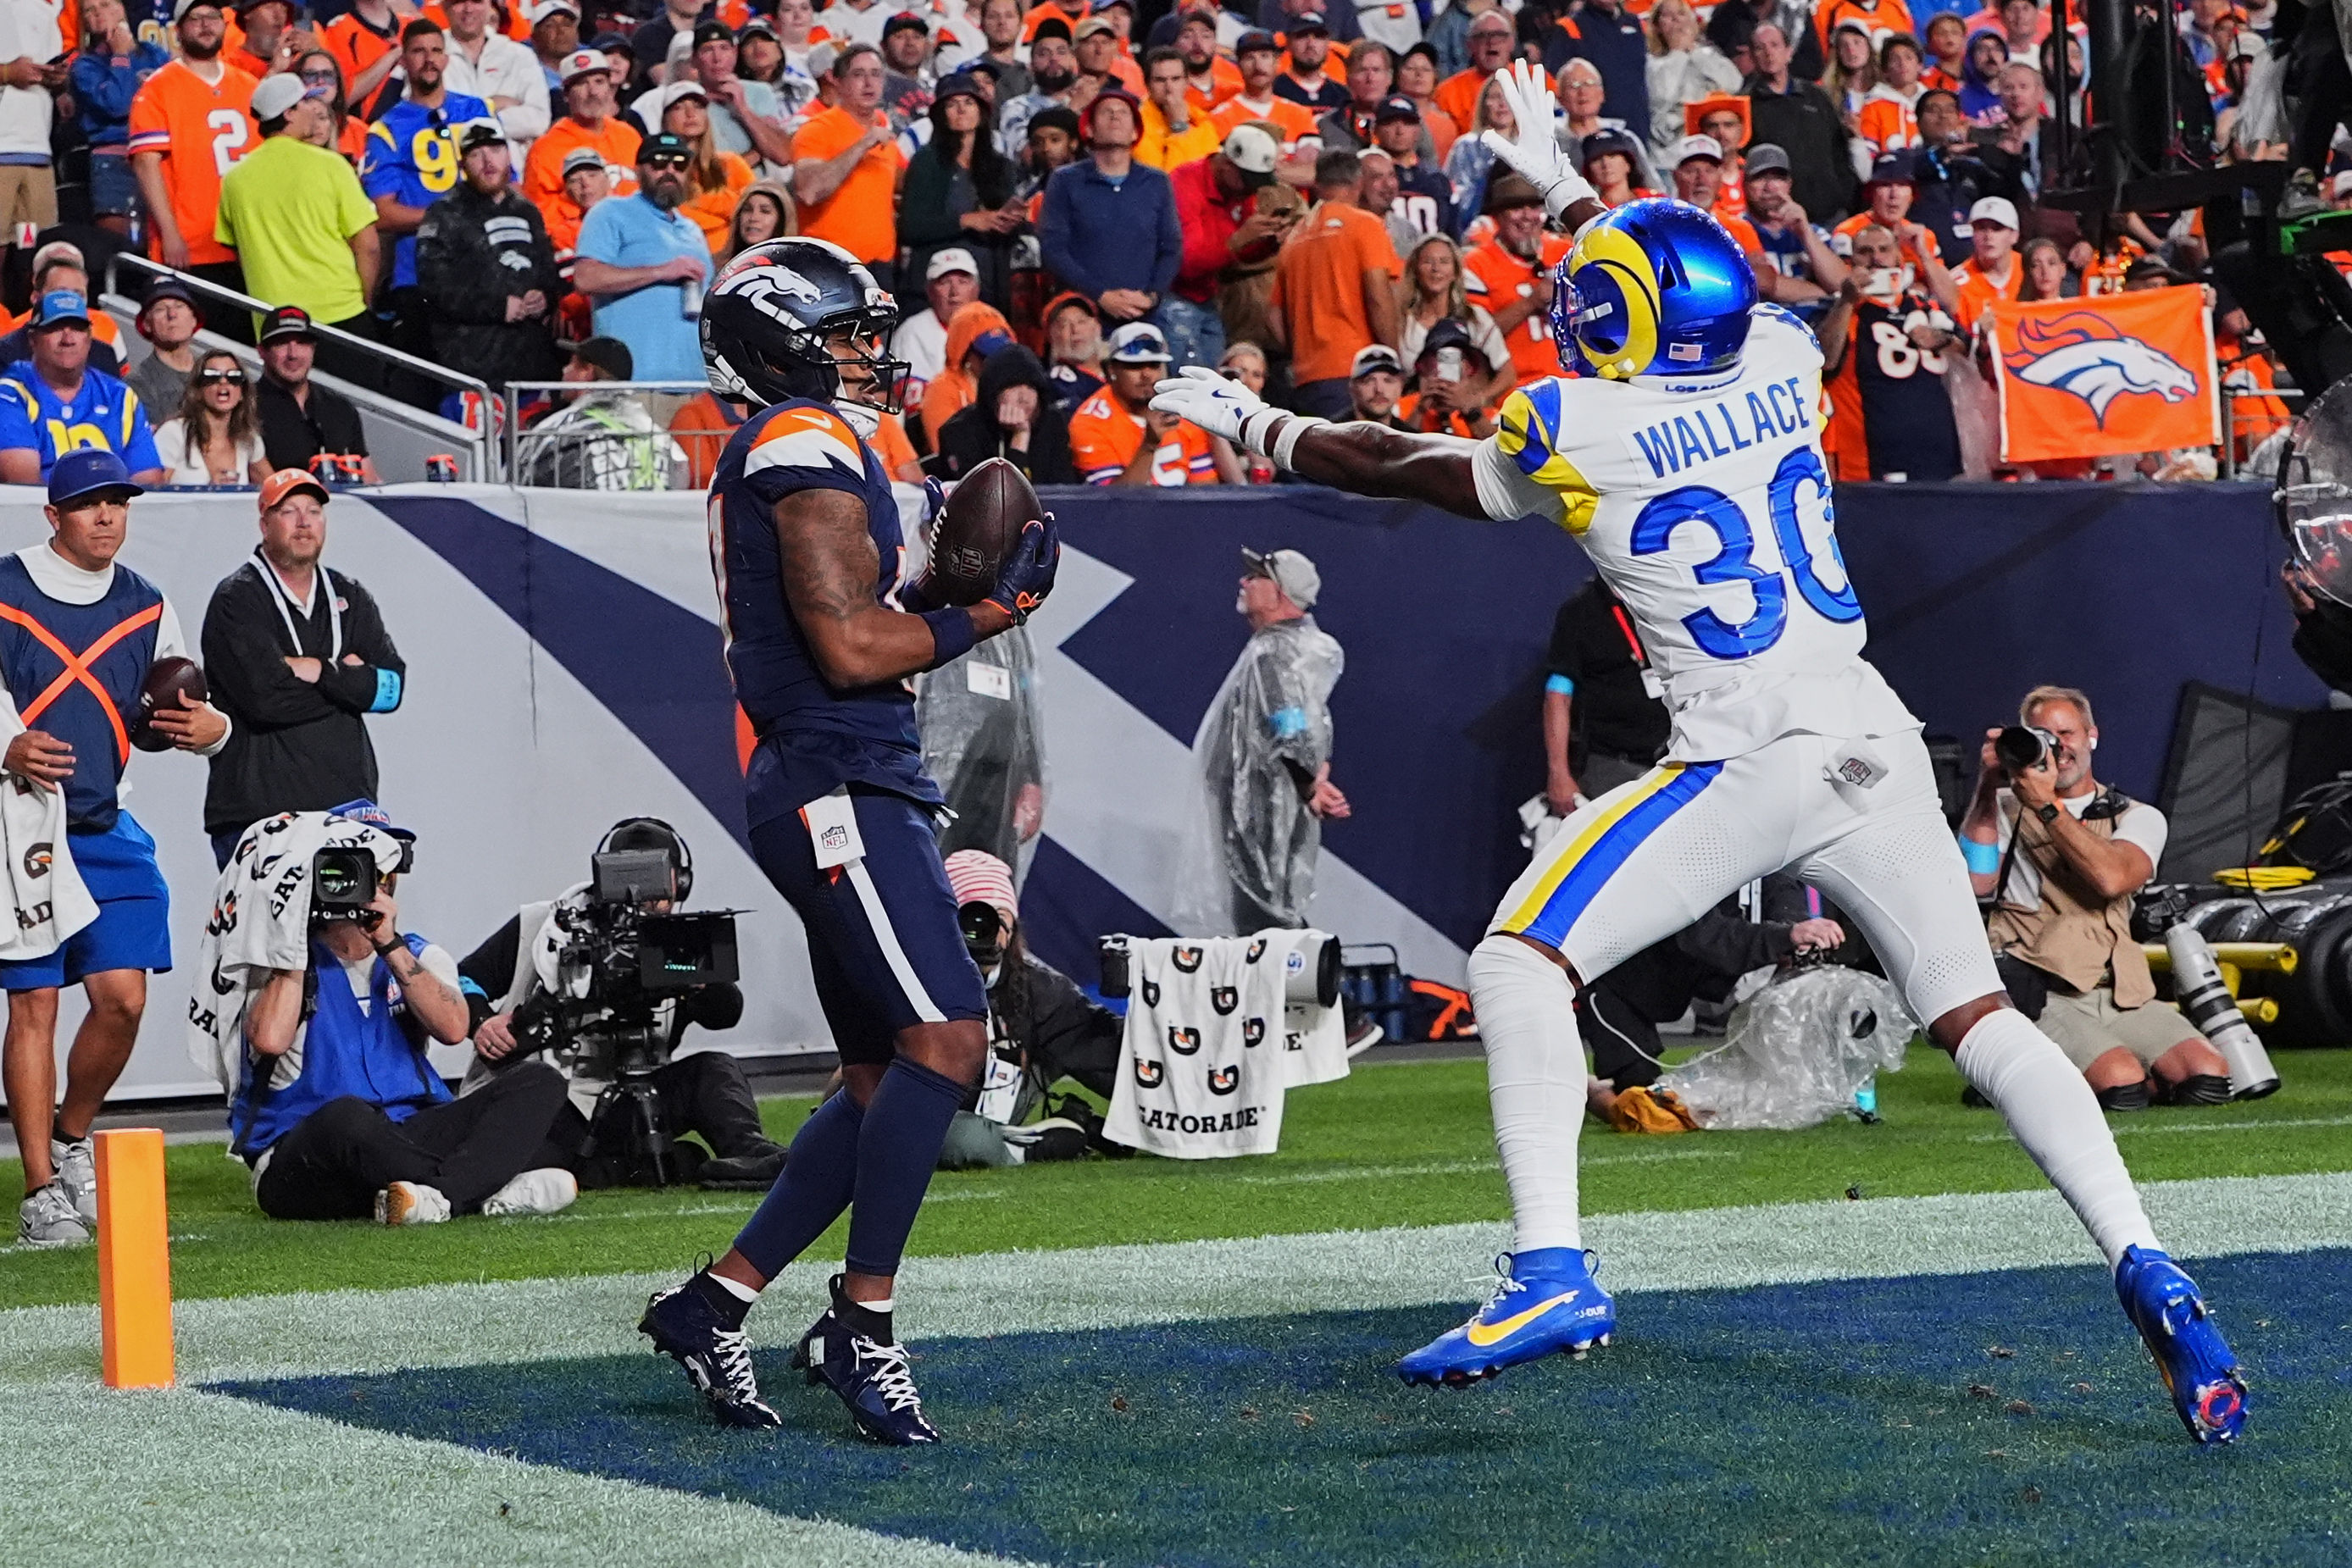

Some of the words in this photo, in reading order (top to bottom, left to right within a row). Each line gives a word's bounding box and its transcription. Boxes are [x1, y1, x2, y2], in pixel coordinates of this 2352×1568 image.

[207, 108, 247, 178] 2
[1633, 376, 1811, 479] WALLACE
[960, 546, 984, 578] NFL
[1629, 444, 1864, 661] 30
[824, 834, 846, 847] NFL
[1283, 1032, 1302, 1052] E
